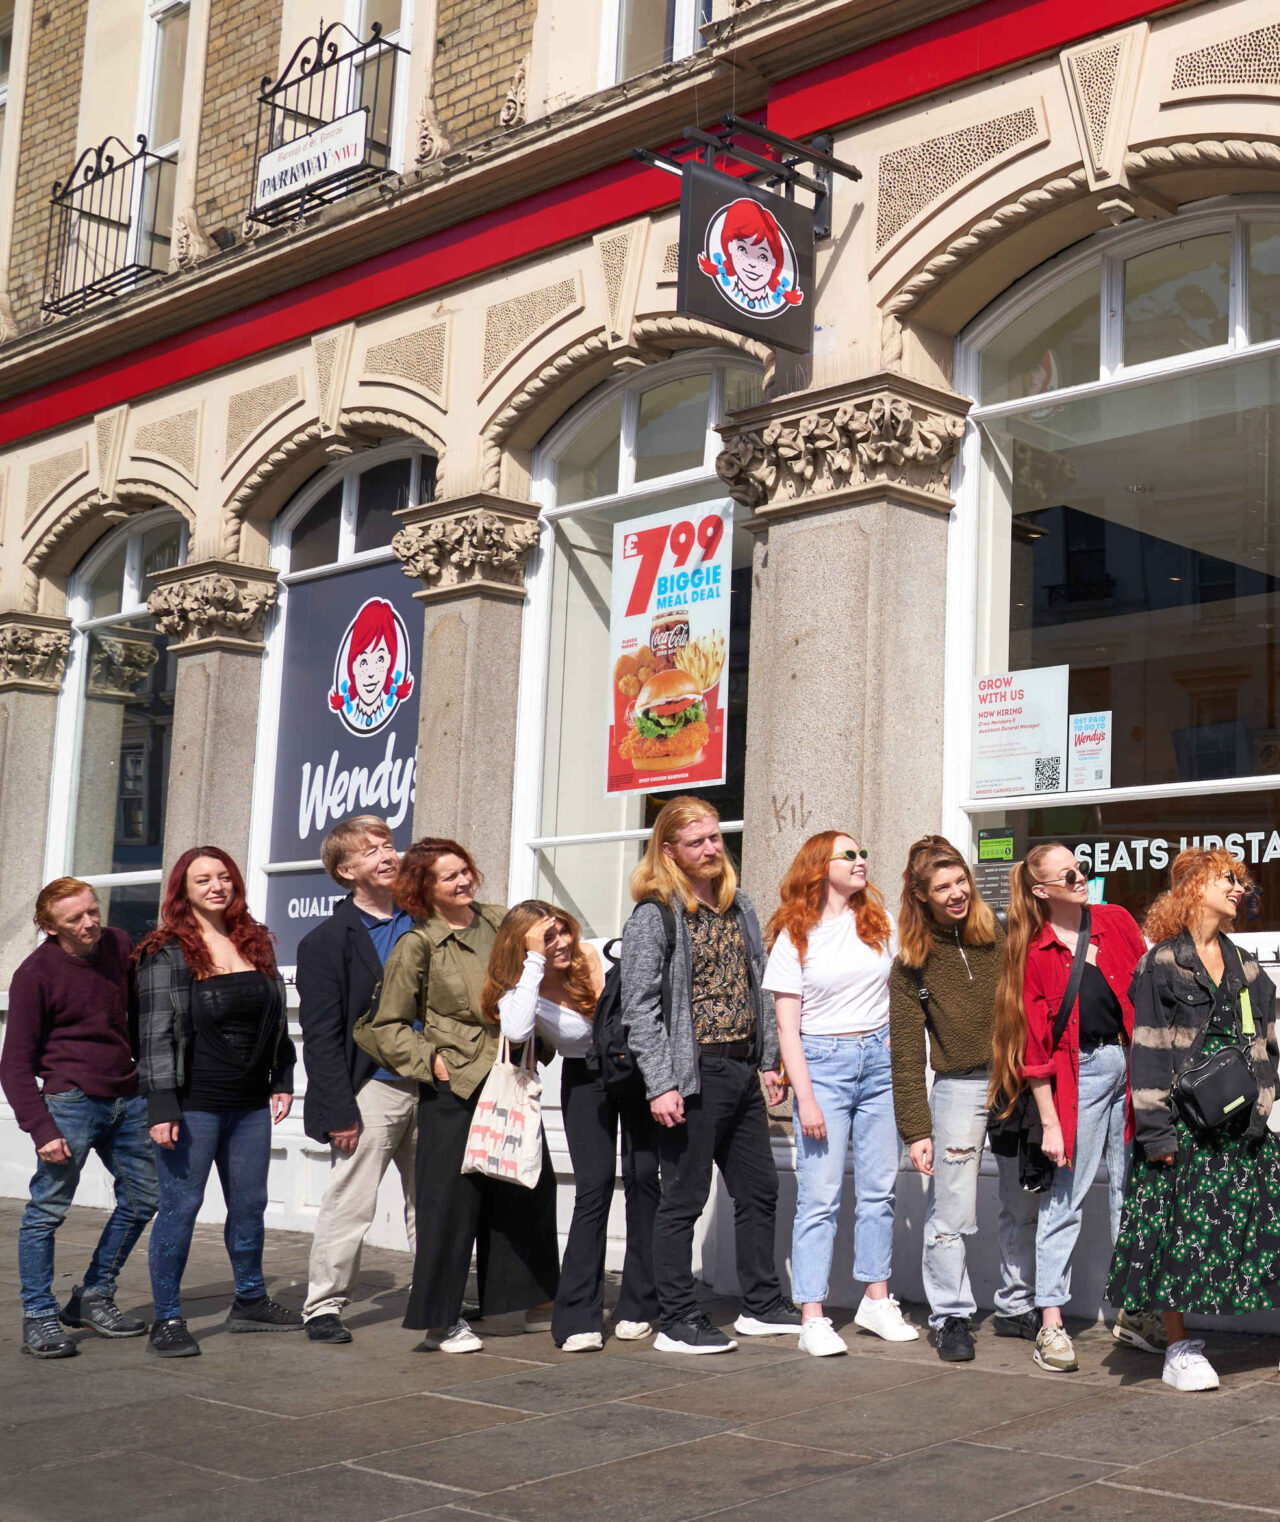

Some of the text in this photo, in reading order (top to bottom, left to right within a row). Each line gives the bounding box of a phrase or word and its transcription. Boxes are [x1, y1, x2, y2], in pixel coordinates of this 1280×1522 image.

[262, 143, 358, 197] PARKWAY NW1
[657, 564, 722, 596] BIGGIE
[656, 586, 721, 609] MEAL DEAL
[978, 676, 1014, 691] GROW
[978, 688, 1025, 704] WITH US
[978, 707, 1023, 719] NOW HIRING
[1073, 715, 1106, 725] GET PAID
[1084, 723, 1095, 731] GO
[1074, 728, 1106, 748] Wendy's
[1074, 837, 1169, 873] SEATS
[287, 895, 347, 919] QUALI
